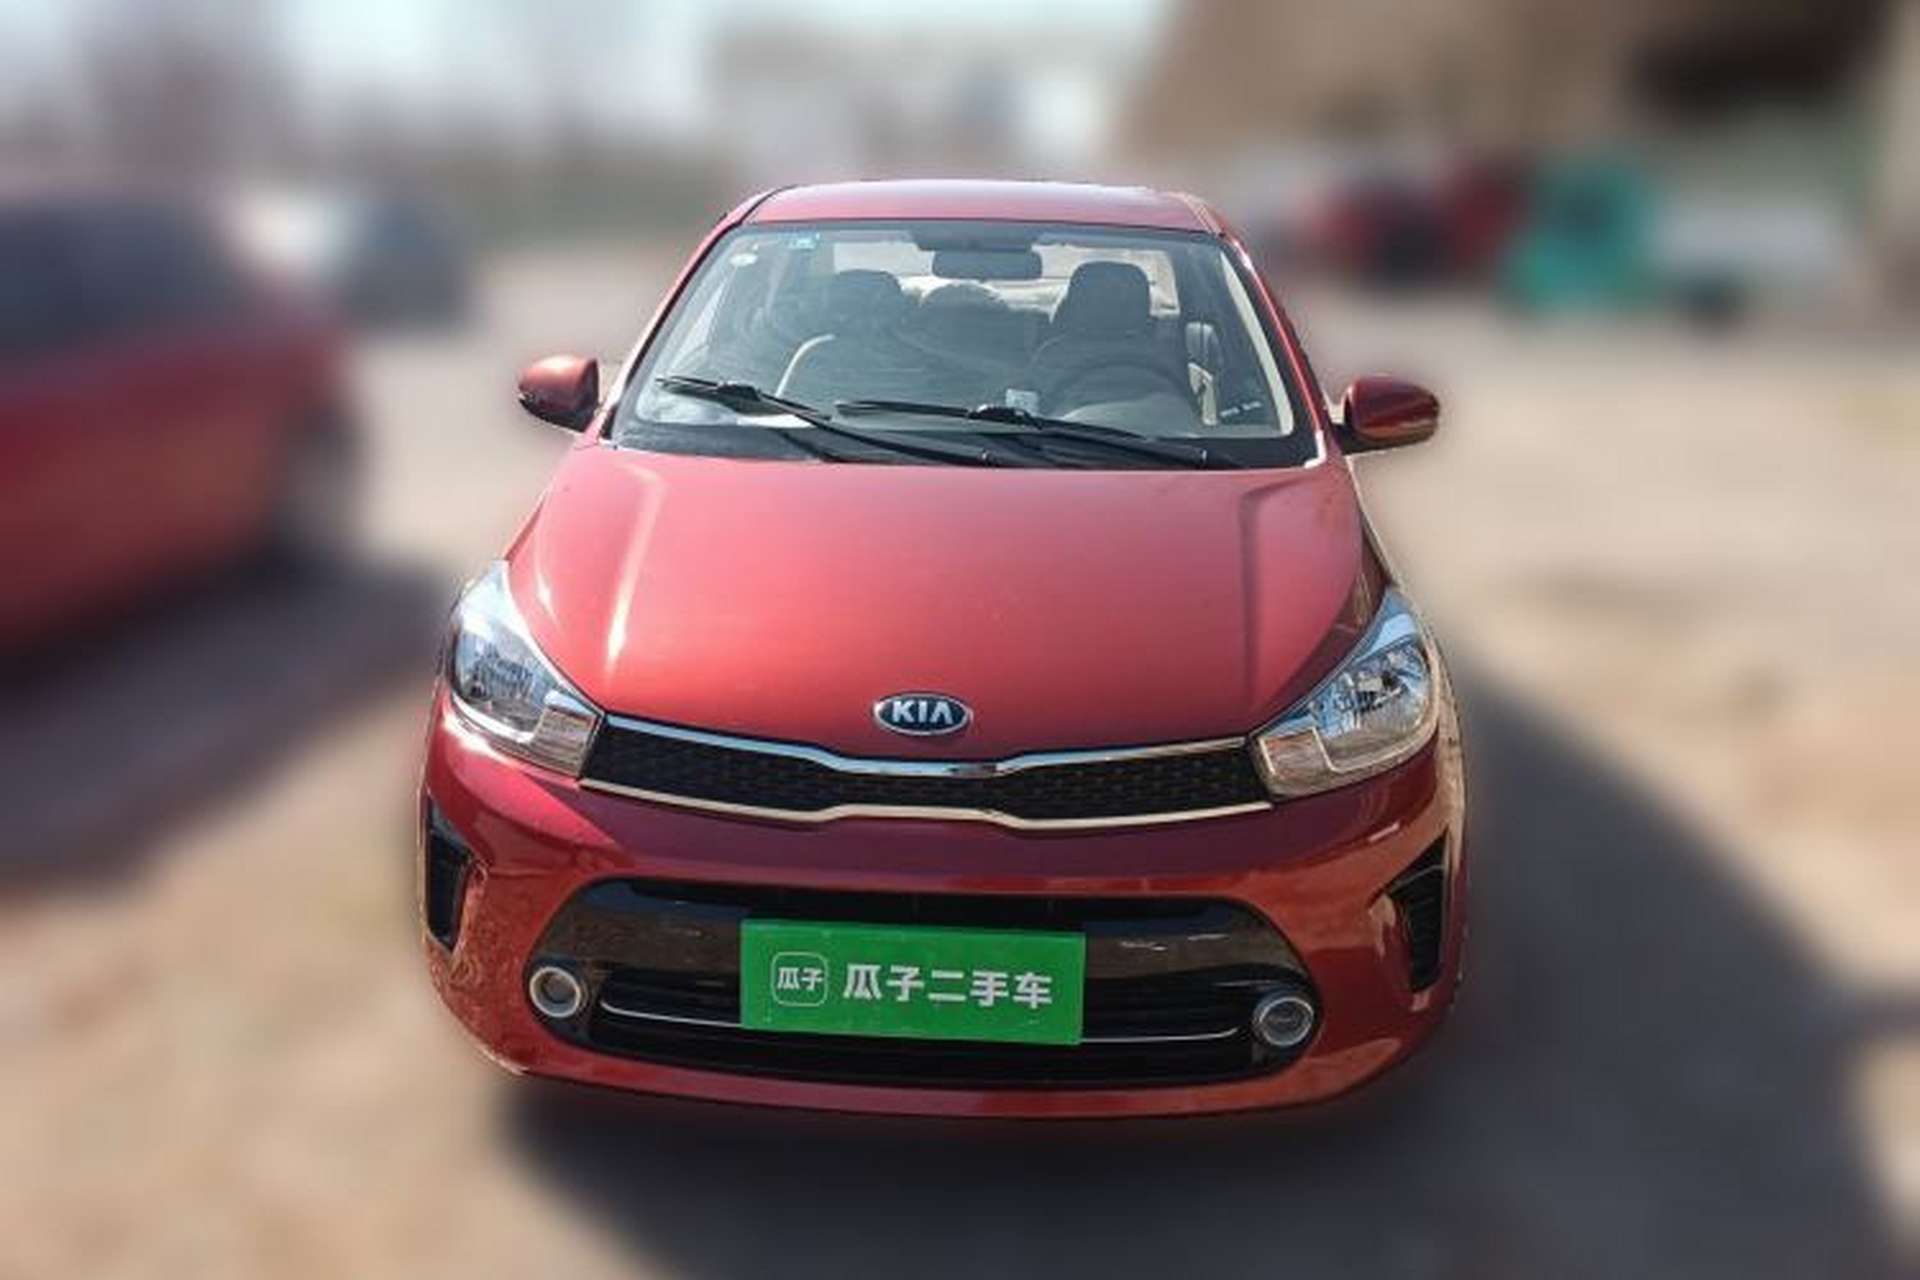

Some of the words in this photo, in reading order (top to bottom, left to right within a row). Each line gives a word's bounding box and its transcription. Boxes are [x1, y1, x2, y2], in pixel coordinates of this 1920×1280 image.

[892, 700, 954, 724] KIA
[776, 966, 823, 991] 瓜子
[843, 964, 1053, 1008] 瓜子二手车
